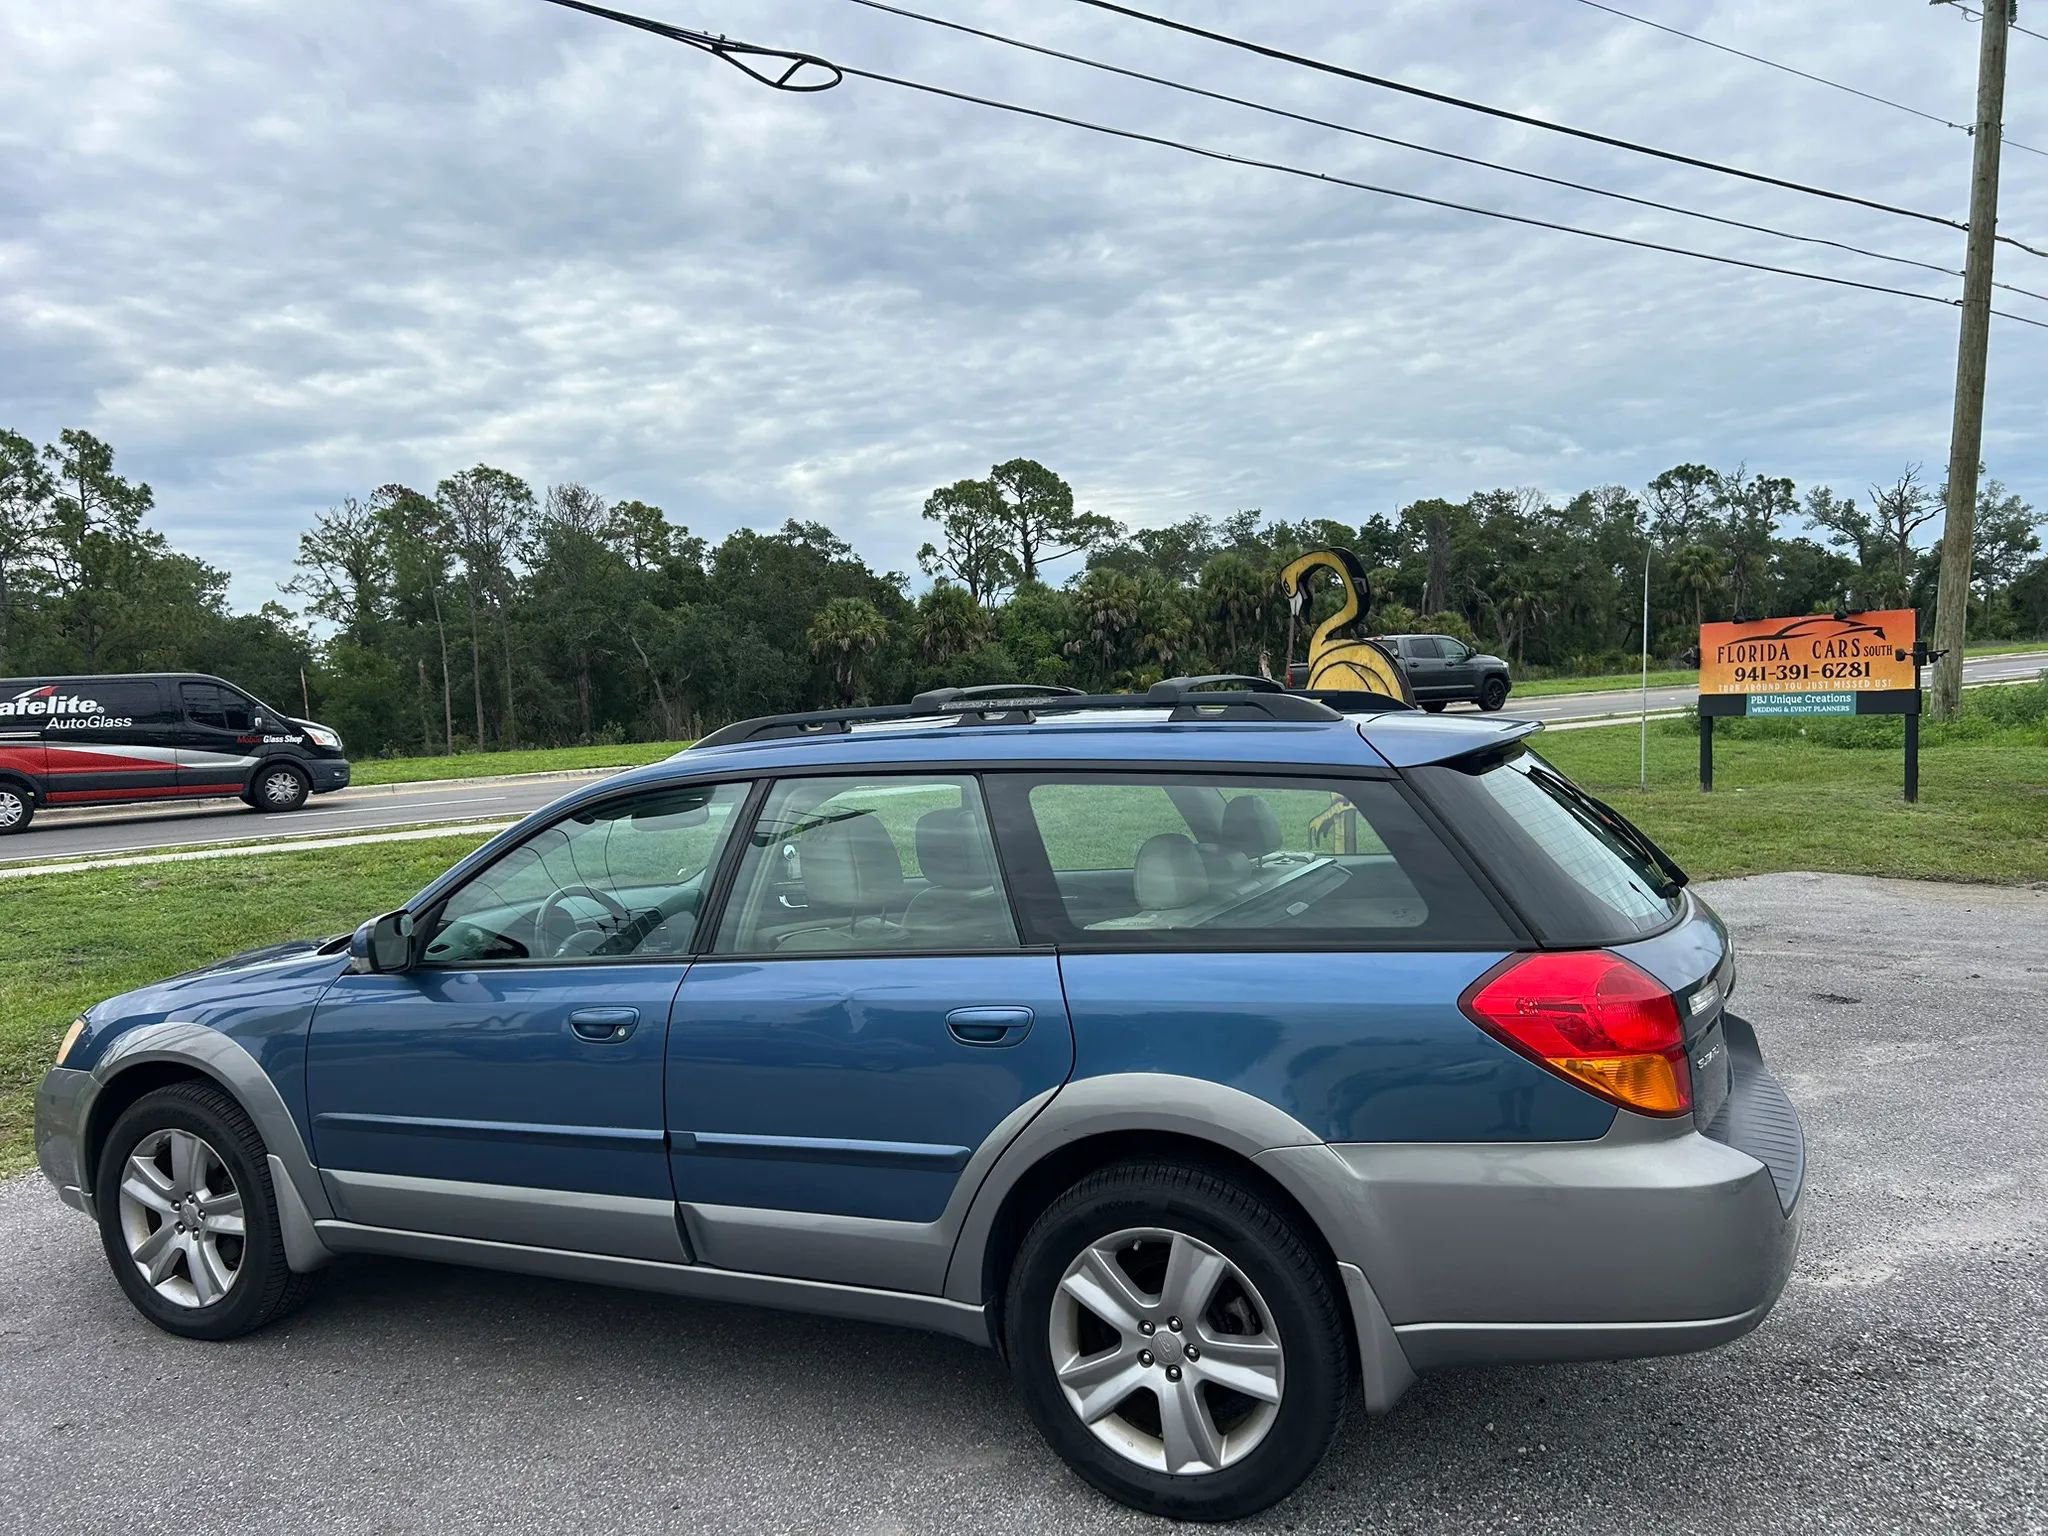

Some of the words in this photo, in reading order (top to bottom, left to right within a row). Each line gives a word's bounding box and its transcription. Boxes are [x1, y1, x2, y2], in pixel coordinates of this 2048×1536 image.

[1717, 642, 1790, 664] FLORIDA
[1812, 638, 1860, 659] CARS
[1863, 644, 1893, 657] SOUTH
[1734, 661, 1871, 682] 941-391-6281
[1744, 682, 1780, 692] AROUND
[1784, 681, 1802, 691] YOU
[1806, 680, 1829, 690] JUST
[1833, 679, 1870, 689] MISSED
[1750, 695, 1767, 704] PBJ
[1769, 694, 1802, 705] Unique
[1804, 693, 1852, 704] Creations
[45, 715, 133, 730] AutoGlass
